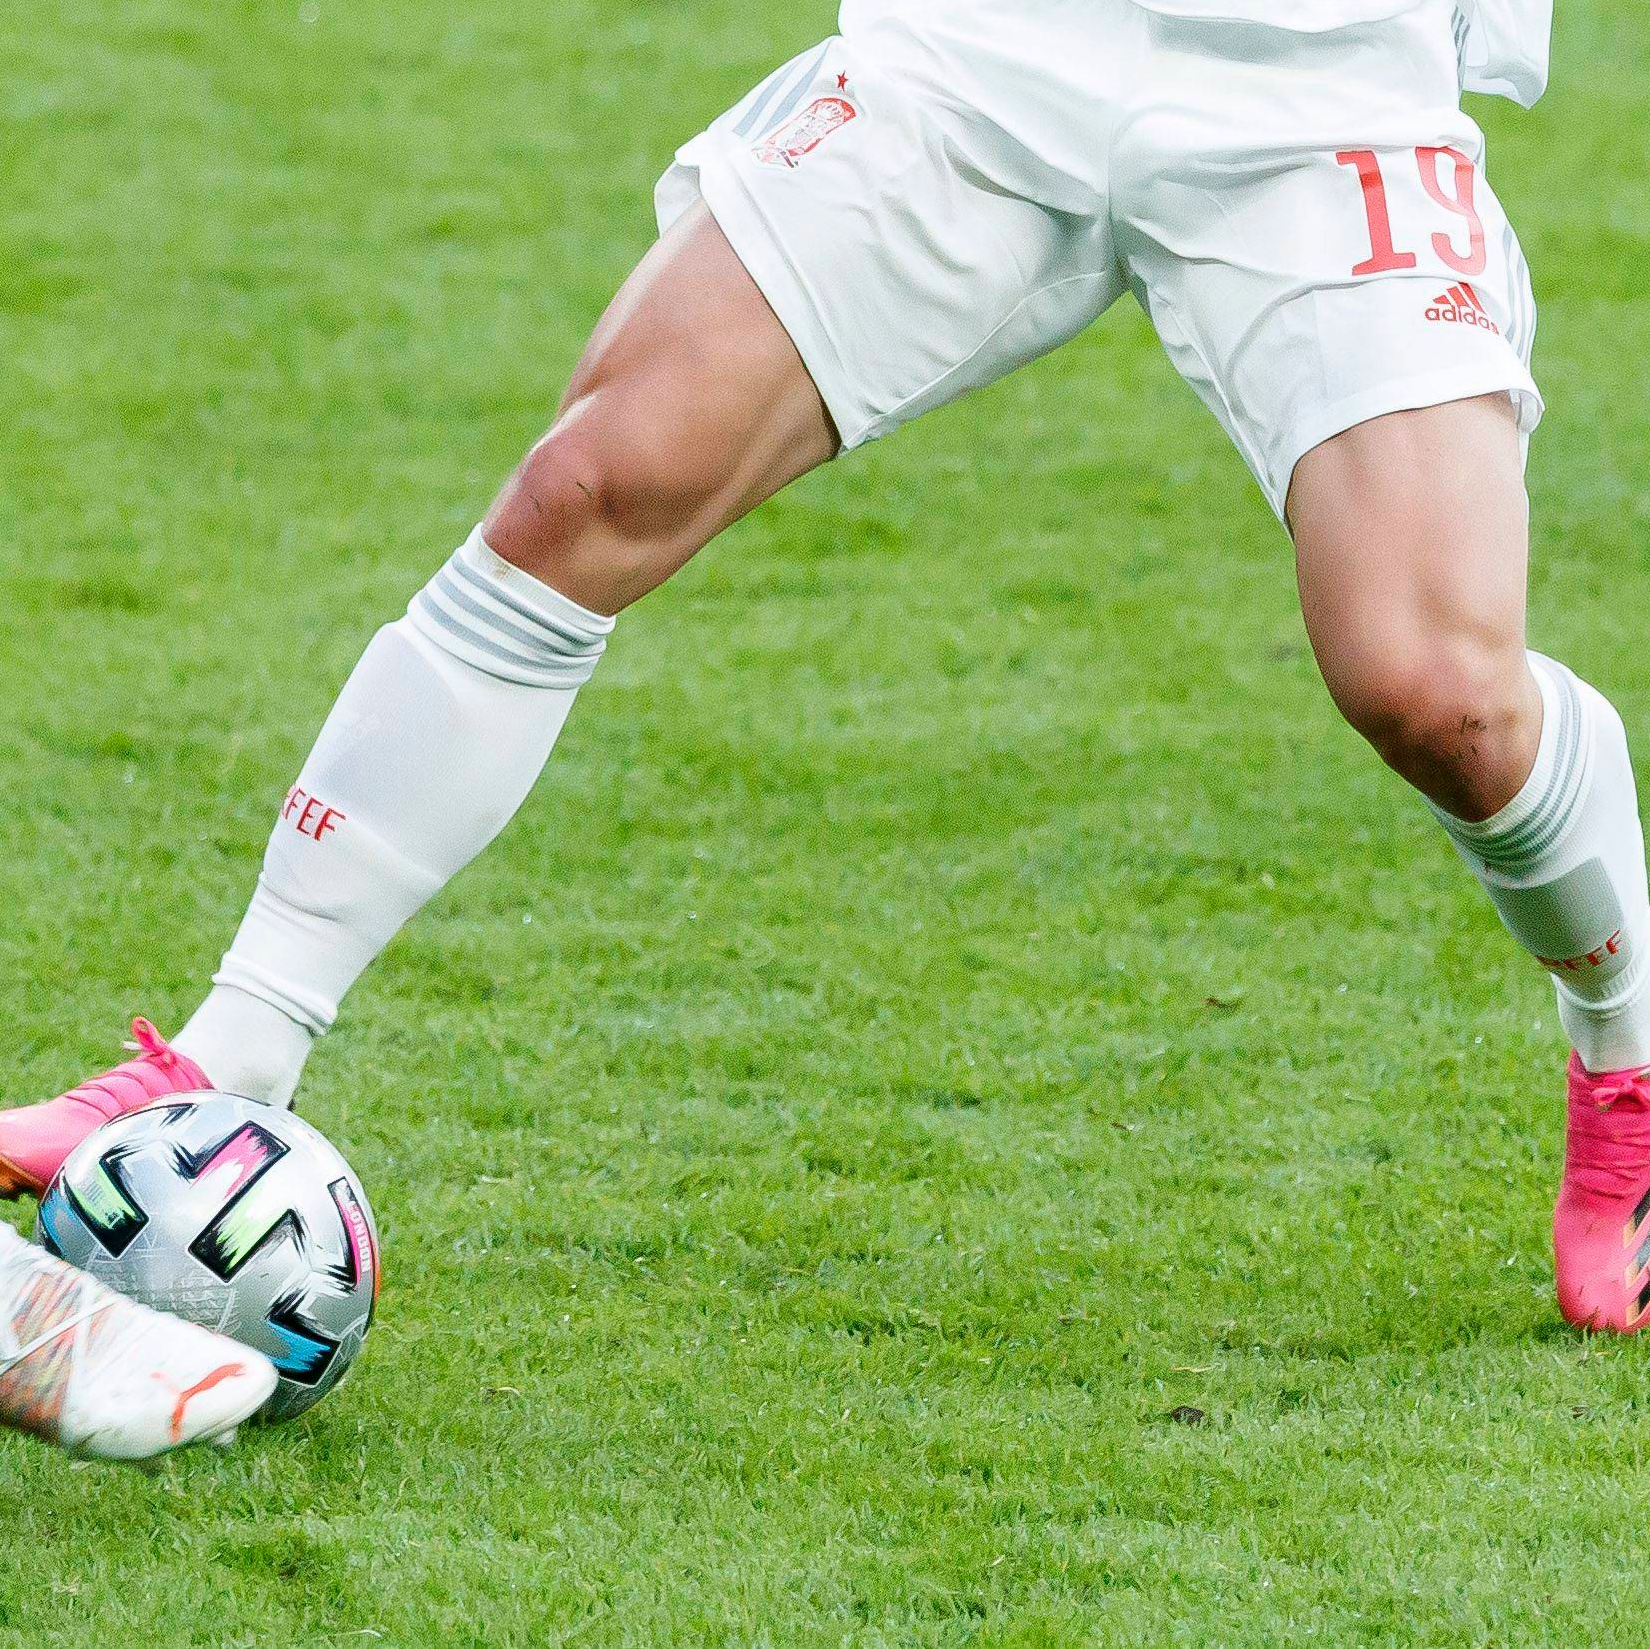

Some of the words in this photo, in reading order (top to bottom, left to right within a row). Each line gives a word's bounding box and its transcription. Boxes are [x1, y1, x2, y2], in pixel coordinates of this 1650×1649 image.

[1335, 145, 1488, 277] 19
[1424, 303, 1500, 336] adidas
[281, 786, 347, 842] FEF
